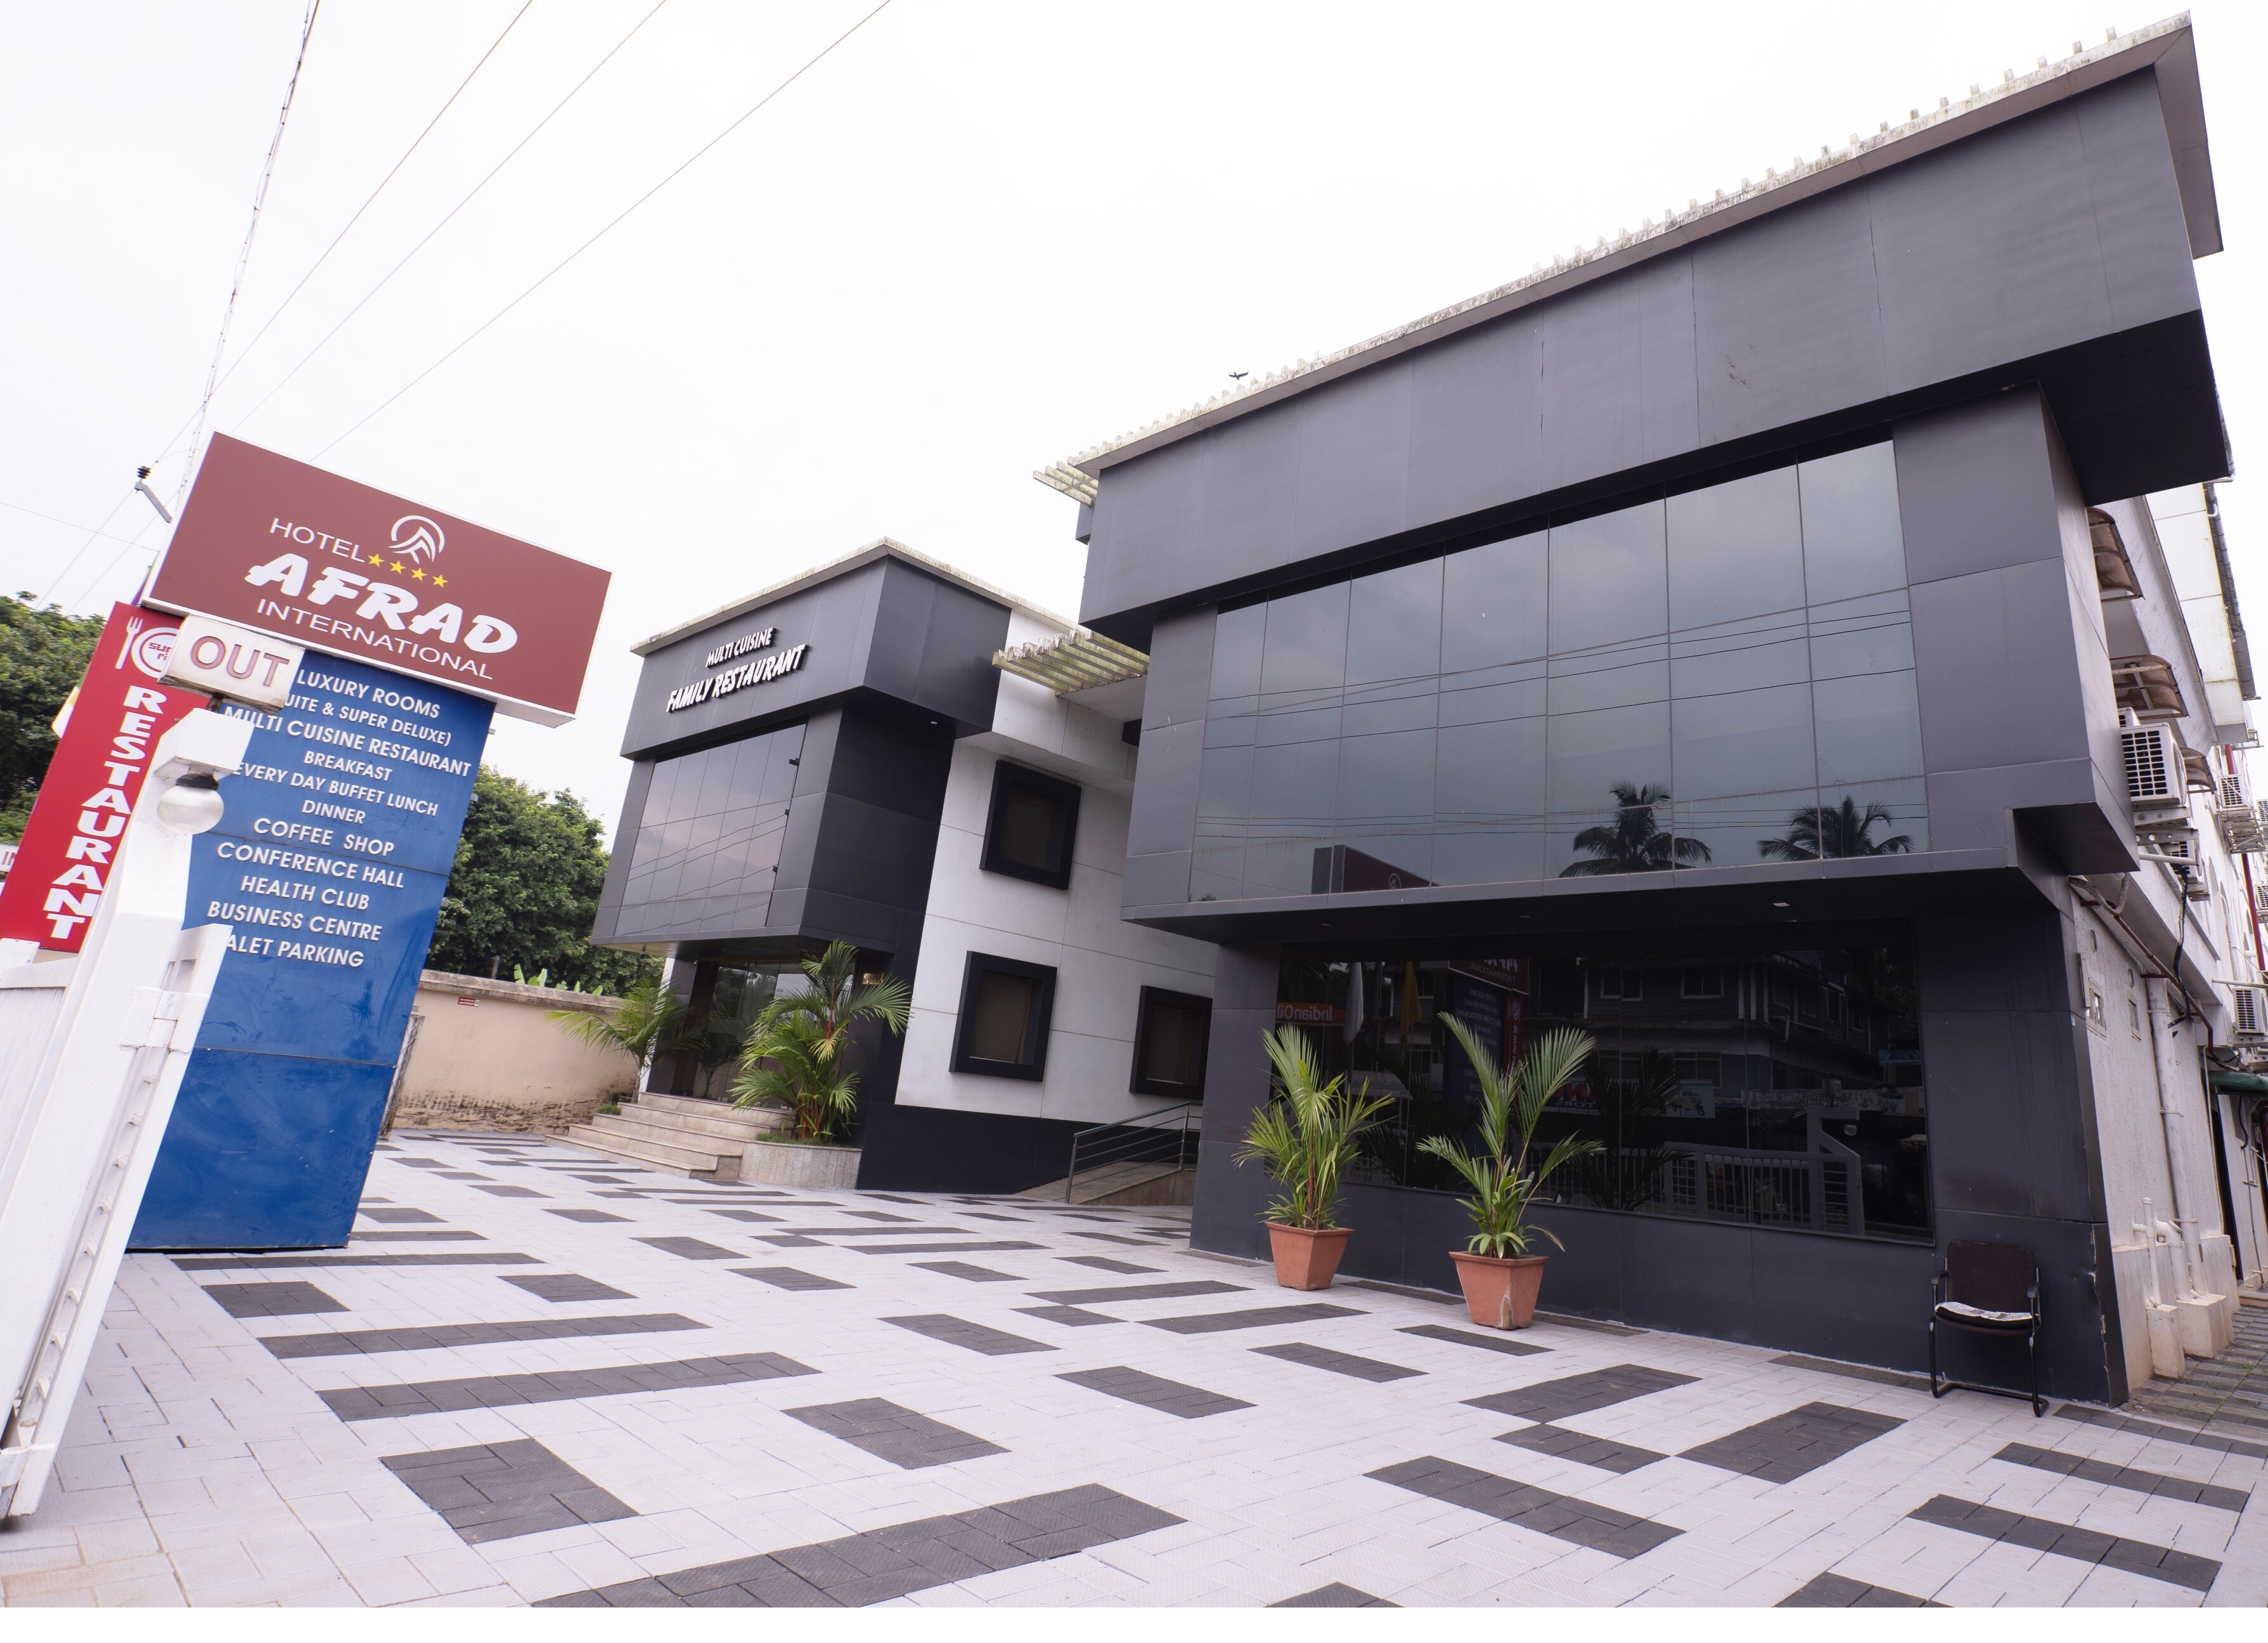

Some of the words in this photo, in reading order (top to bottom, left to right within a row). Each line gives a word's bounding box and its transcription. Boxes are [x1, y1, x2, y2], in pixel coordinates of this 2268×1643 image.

[269, 517, 365, 563] HOTEL
[244, 553, 518, 654] AFRAD
[190, 635, 290, 688] OUT
[257, 598, 493, 680] INTERNATIONAL
[706, 641, 735, 667] MULTI
[734, 627, 773, 656] CUISINE
[297, 669, 370, 699] LUXURY
[373, 688, 441, 719] ROOMS
[666, 678, 714, 712] FAMILY
[712, 643, 807, 698] RESTAURANT
[285, 693, 319, 712] UITE
[322, 702, 335, 716] &
[339, 706, 388, 730] SUPER
[391, 719, 451, 747] DELUXE)
[287, 719, 366, 751] CUISINE
[368, 738, 472, 778] RESTAURANT
[304, 750, 393, 782] BREAKFAST
[43, 685, 168, 939] RESTAURANT
[290, 773, 326, 790] DAY
[328, 780, 385, 804] BUFFET
[387, 792, 439, 816] LUNCH
[302, 799, 366, 825] DINNER
[254, 818, 334, 846] COFFEE
[344, 834, 394, 857] SHOP
[217, 842, 358, 880] CONFERENCE
[362, 866, 404, 889] HALL
[240, 875, 316, 902] HEALTH
[321, 888, 370, 910] CLUB
[207, 901, 304, 929] BUSINESS
[309, 916, 382, 941] CENTRE
[226, 934, 274, 956] ALET
[277, 941, 364, 967] PARKING
